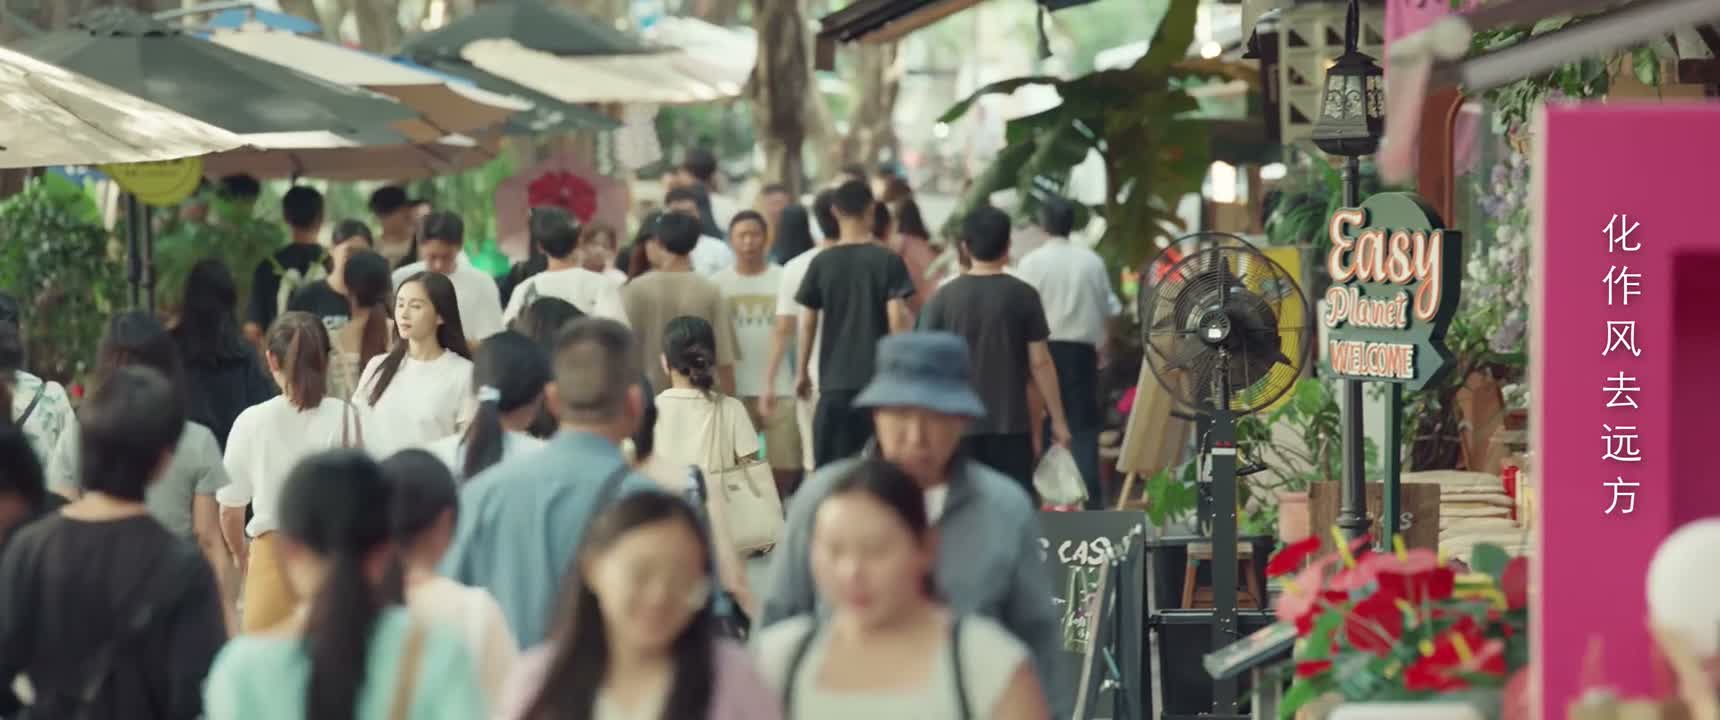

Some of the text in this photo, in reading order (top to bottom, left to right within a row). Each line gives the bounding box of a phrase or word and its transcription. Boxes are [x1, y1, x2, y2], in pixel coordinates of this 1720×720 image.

[1329, 208, 1443, 321] Easy
[1326, 286, 1408, 328] Planet
[1330, 340, 1414, 378] WELCOME
